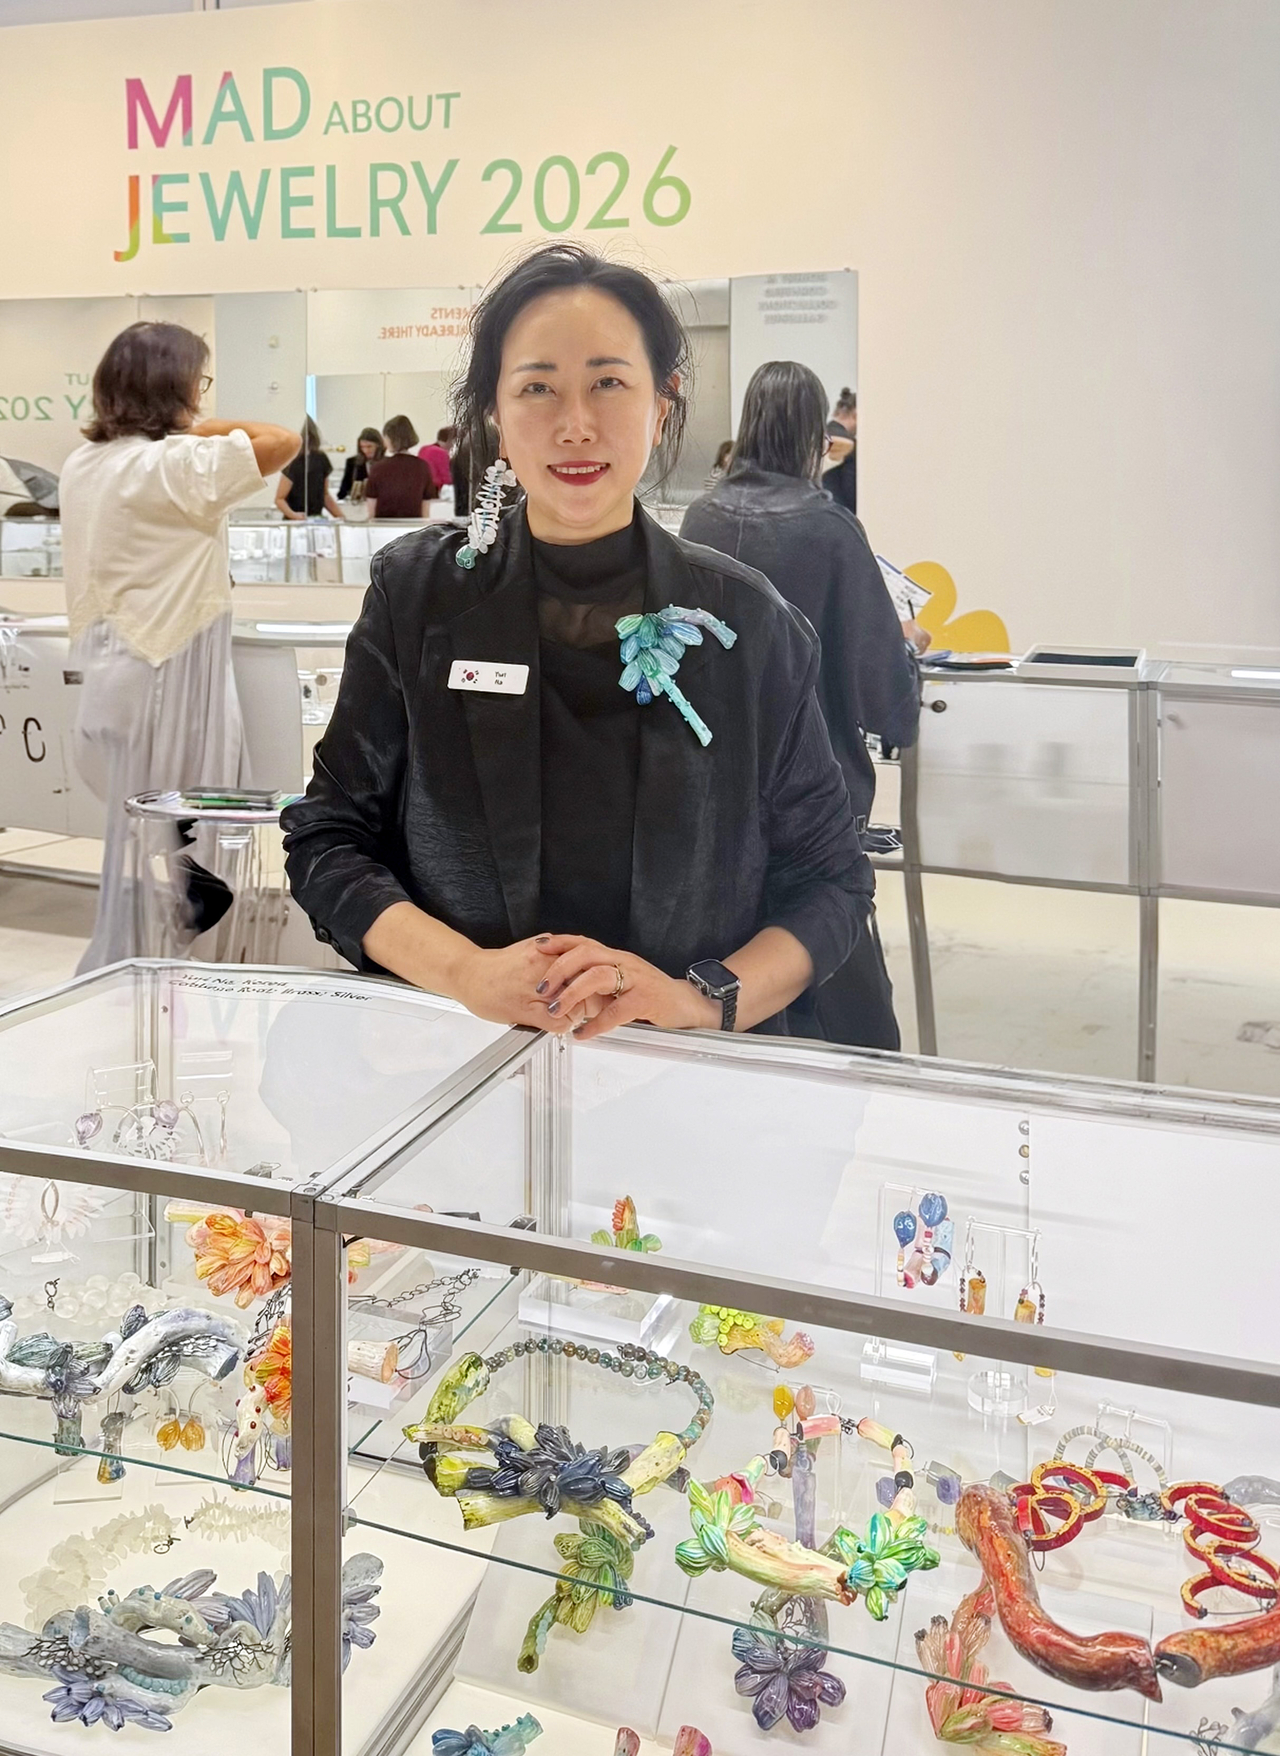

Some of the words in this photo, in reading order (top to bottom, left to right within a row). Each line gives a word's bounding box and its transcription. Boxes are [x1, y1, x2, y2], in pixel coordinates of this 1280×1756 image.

[125, 66, 311, 149] MAD
[322, 91, 461, 135] ABOUT
[113, 158, 460, 262] JEWELRY
[478, 144, 692, 235] 2026
